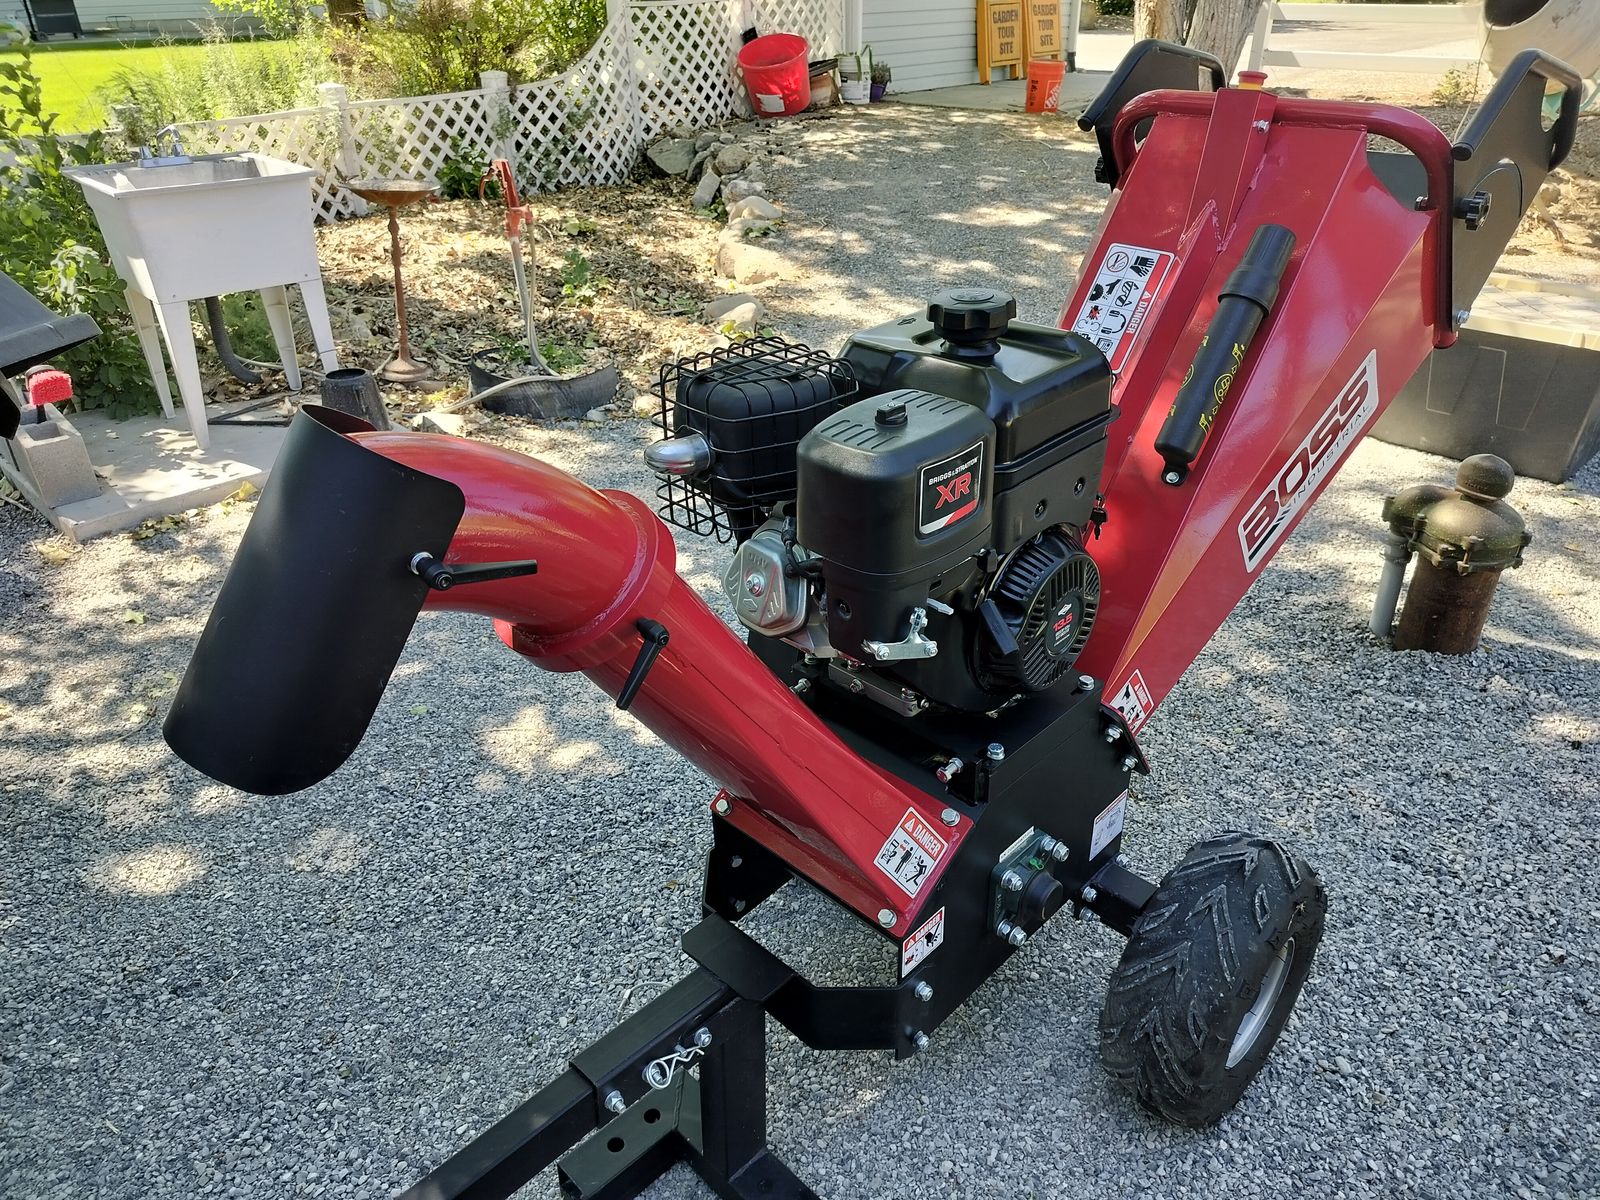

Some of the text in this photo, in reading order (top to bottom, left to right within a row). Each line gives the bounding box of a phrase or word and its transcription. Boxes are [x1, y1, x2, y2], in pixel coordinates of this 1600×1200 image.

[992, 9, 1019, 24] GARDEN
[1032, 3, 1057, 16] GARDEN
[997, 25, 1015, 39] TOUR
[1037, 19, 1054, 32] TOUR
[999, 41, 1014, 55] SITE
[1039, 34, 1054, 47] SITE
[1125, 300, 1148, 335] DANGER
[1242, 365, 1369, 553] BOSS
[1292, 405, 1371, 504] INDUSTRIAL
[935, 472, 972, 510] XR
[912, 825, 942, 858] DANGER
